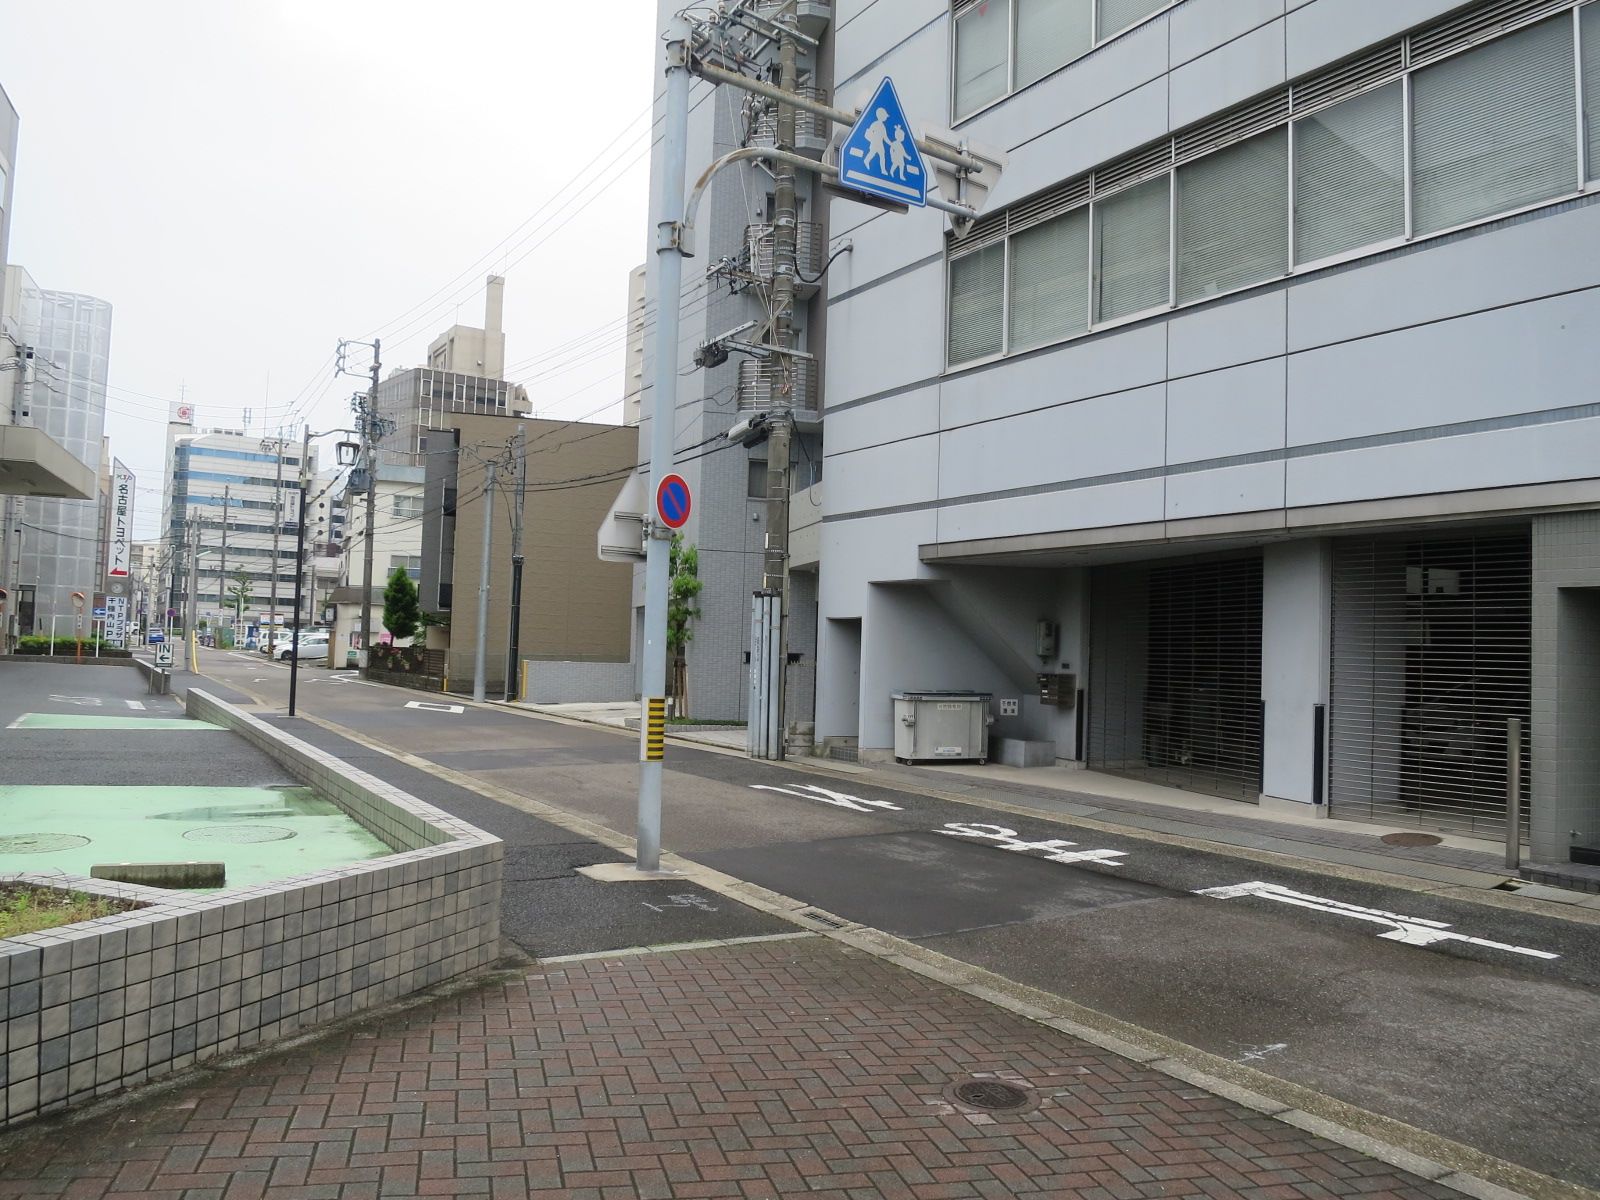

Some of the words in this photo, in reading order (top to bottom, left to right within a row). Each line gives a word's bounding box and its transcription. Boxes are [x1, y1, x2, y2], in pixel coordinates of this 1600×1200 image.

[115, 484, 128, 565] 名古屋トヨペット
[158, 644, 171, 654] IN
